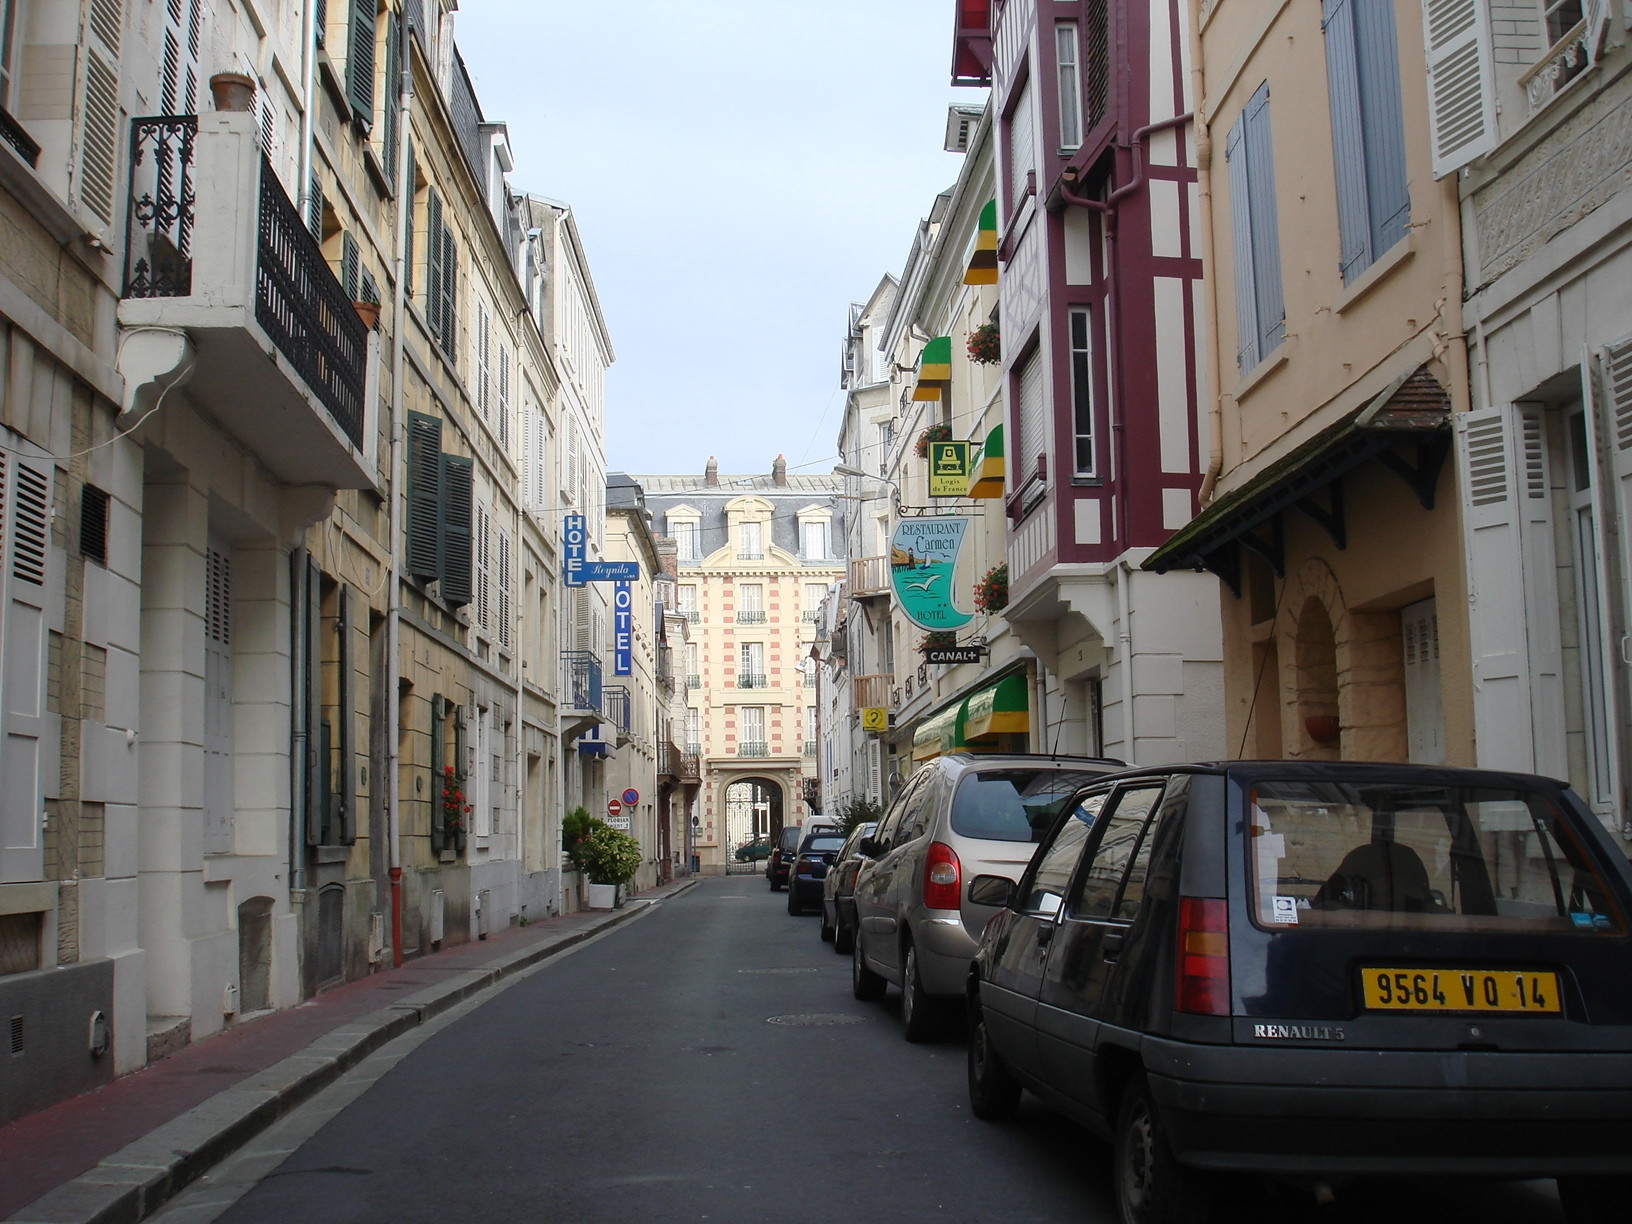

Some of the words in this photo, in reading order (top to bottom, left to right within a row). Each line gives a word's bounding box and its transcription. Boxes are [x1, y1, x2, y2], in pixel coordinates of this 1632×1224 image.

[940, 478, 960, 486] Logis
[932, 485, 942, 493] de
[943, 485, 968, 493] France
[902, 523, 961, 536] RESTAURANT
[567, 516, 583, 586] HOTEL
[915, 535, 955, 554] Carmen
[917, 610, 947, 621] HOTEL
[930, 651, 977, 661] CANAL+
[1377, 973, 1446, 1006] 9564
[1515, 974, 1546, 1008] 14
[1254, 1024, 1332, 1040] RENAULT
[1335, 1027, 1345, 1040] 5
